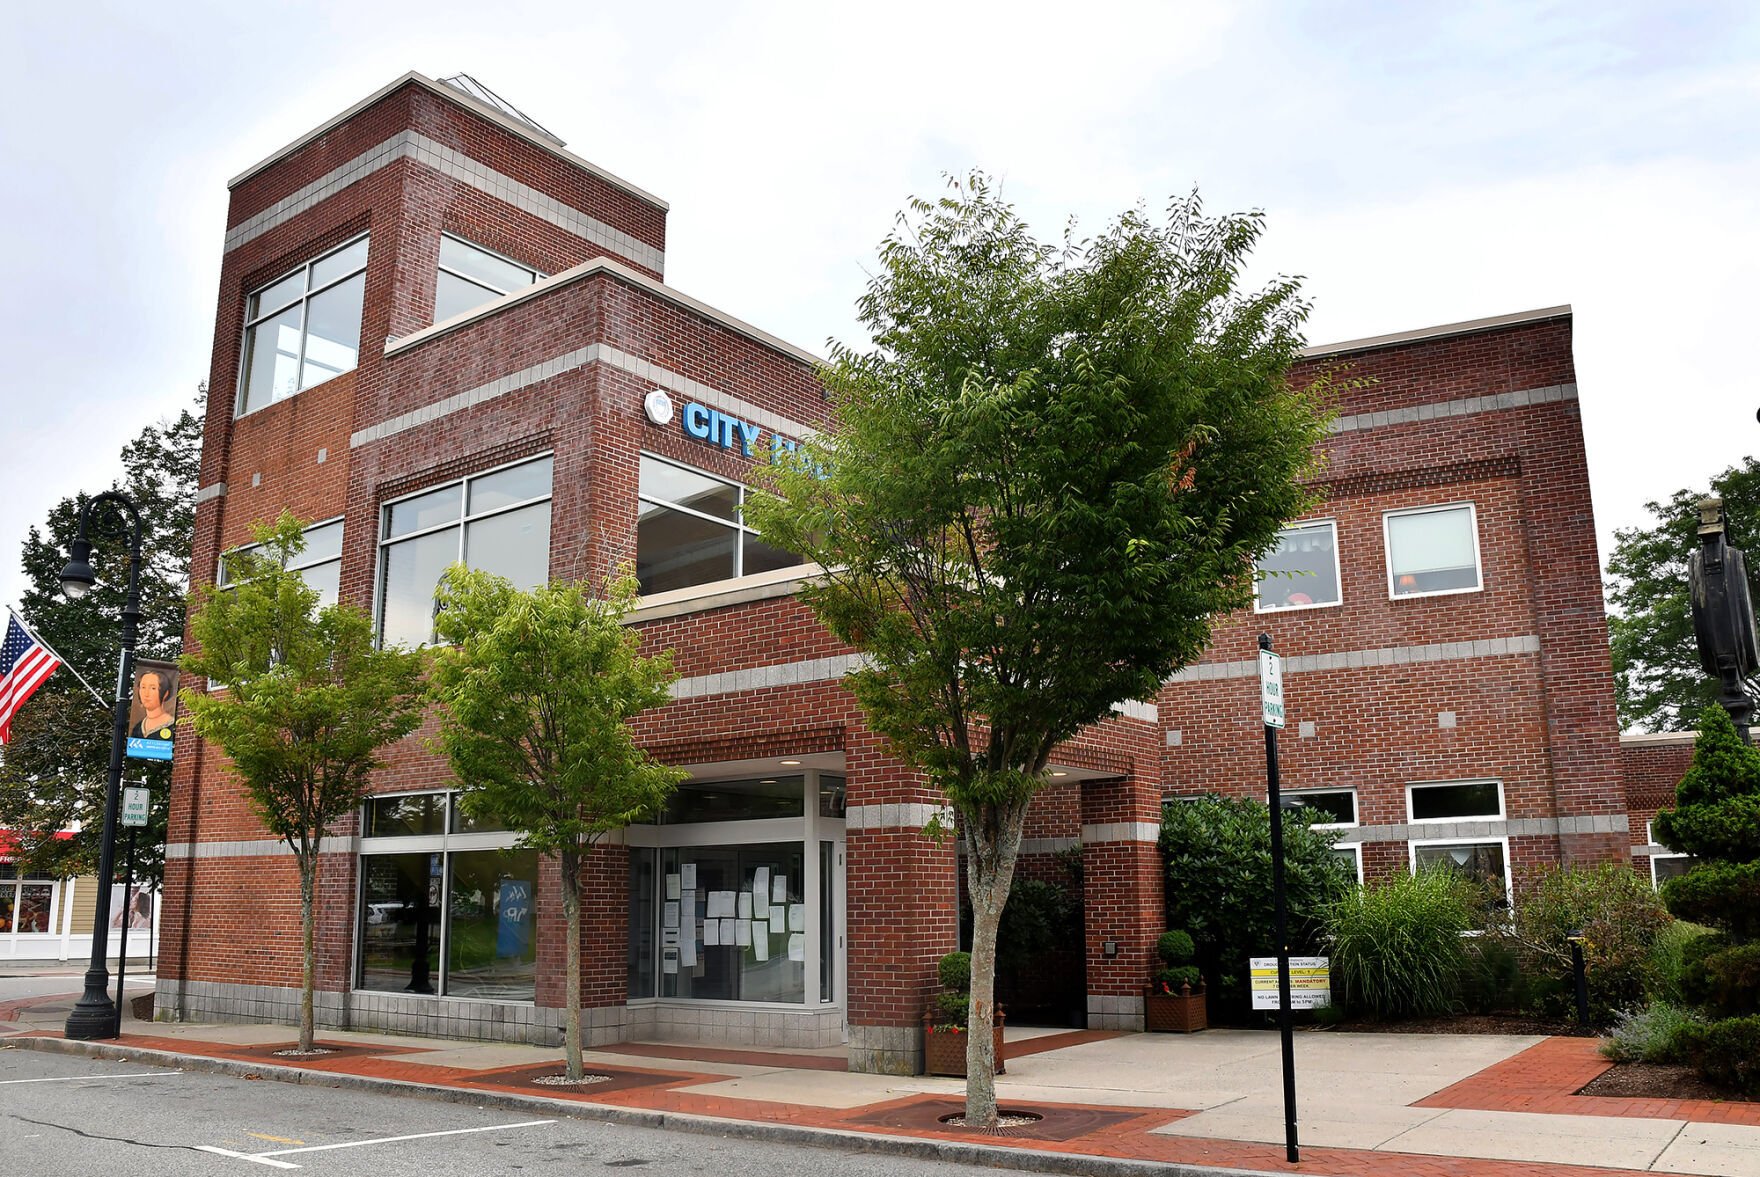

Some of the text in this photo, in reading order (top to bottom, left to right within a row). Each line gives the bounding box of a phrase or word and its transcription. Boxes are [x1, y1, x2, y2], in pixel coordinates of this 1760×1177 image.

[683, 402, 762, 458] CITY
[1269, 662, 1274, 676] 2
[1266, 681, 1279, 697] HOUR
[1265, 701, 1283, 718] PARKING
[128, 803, 144, 811] HOUR
[124, 813, 146, 821] PARKING
